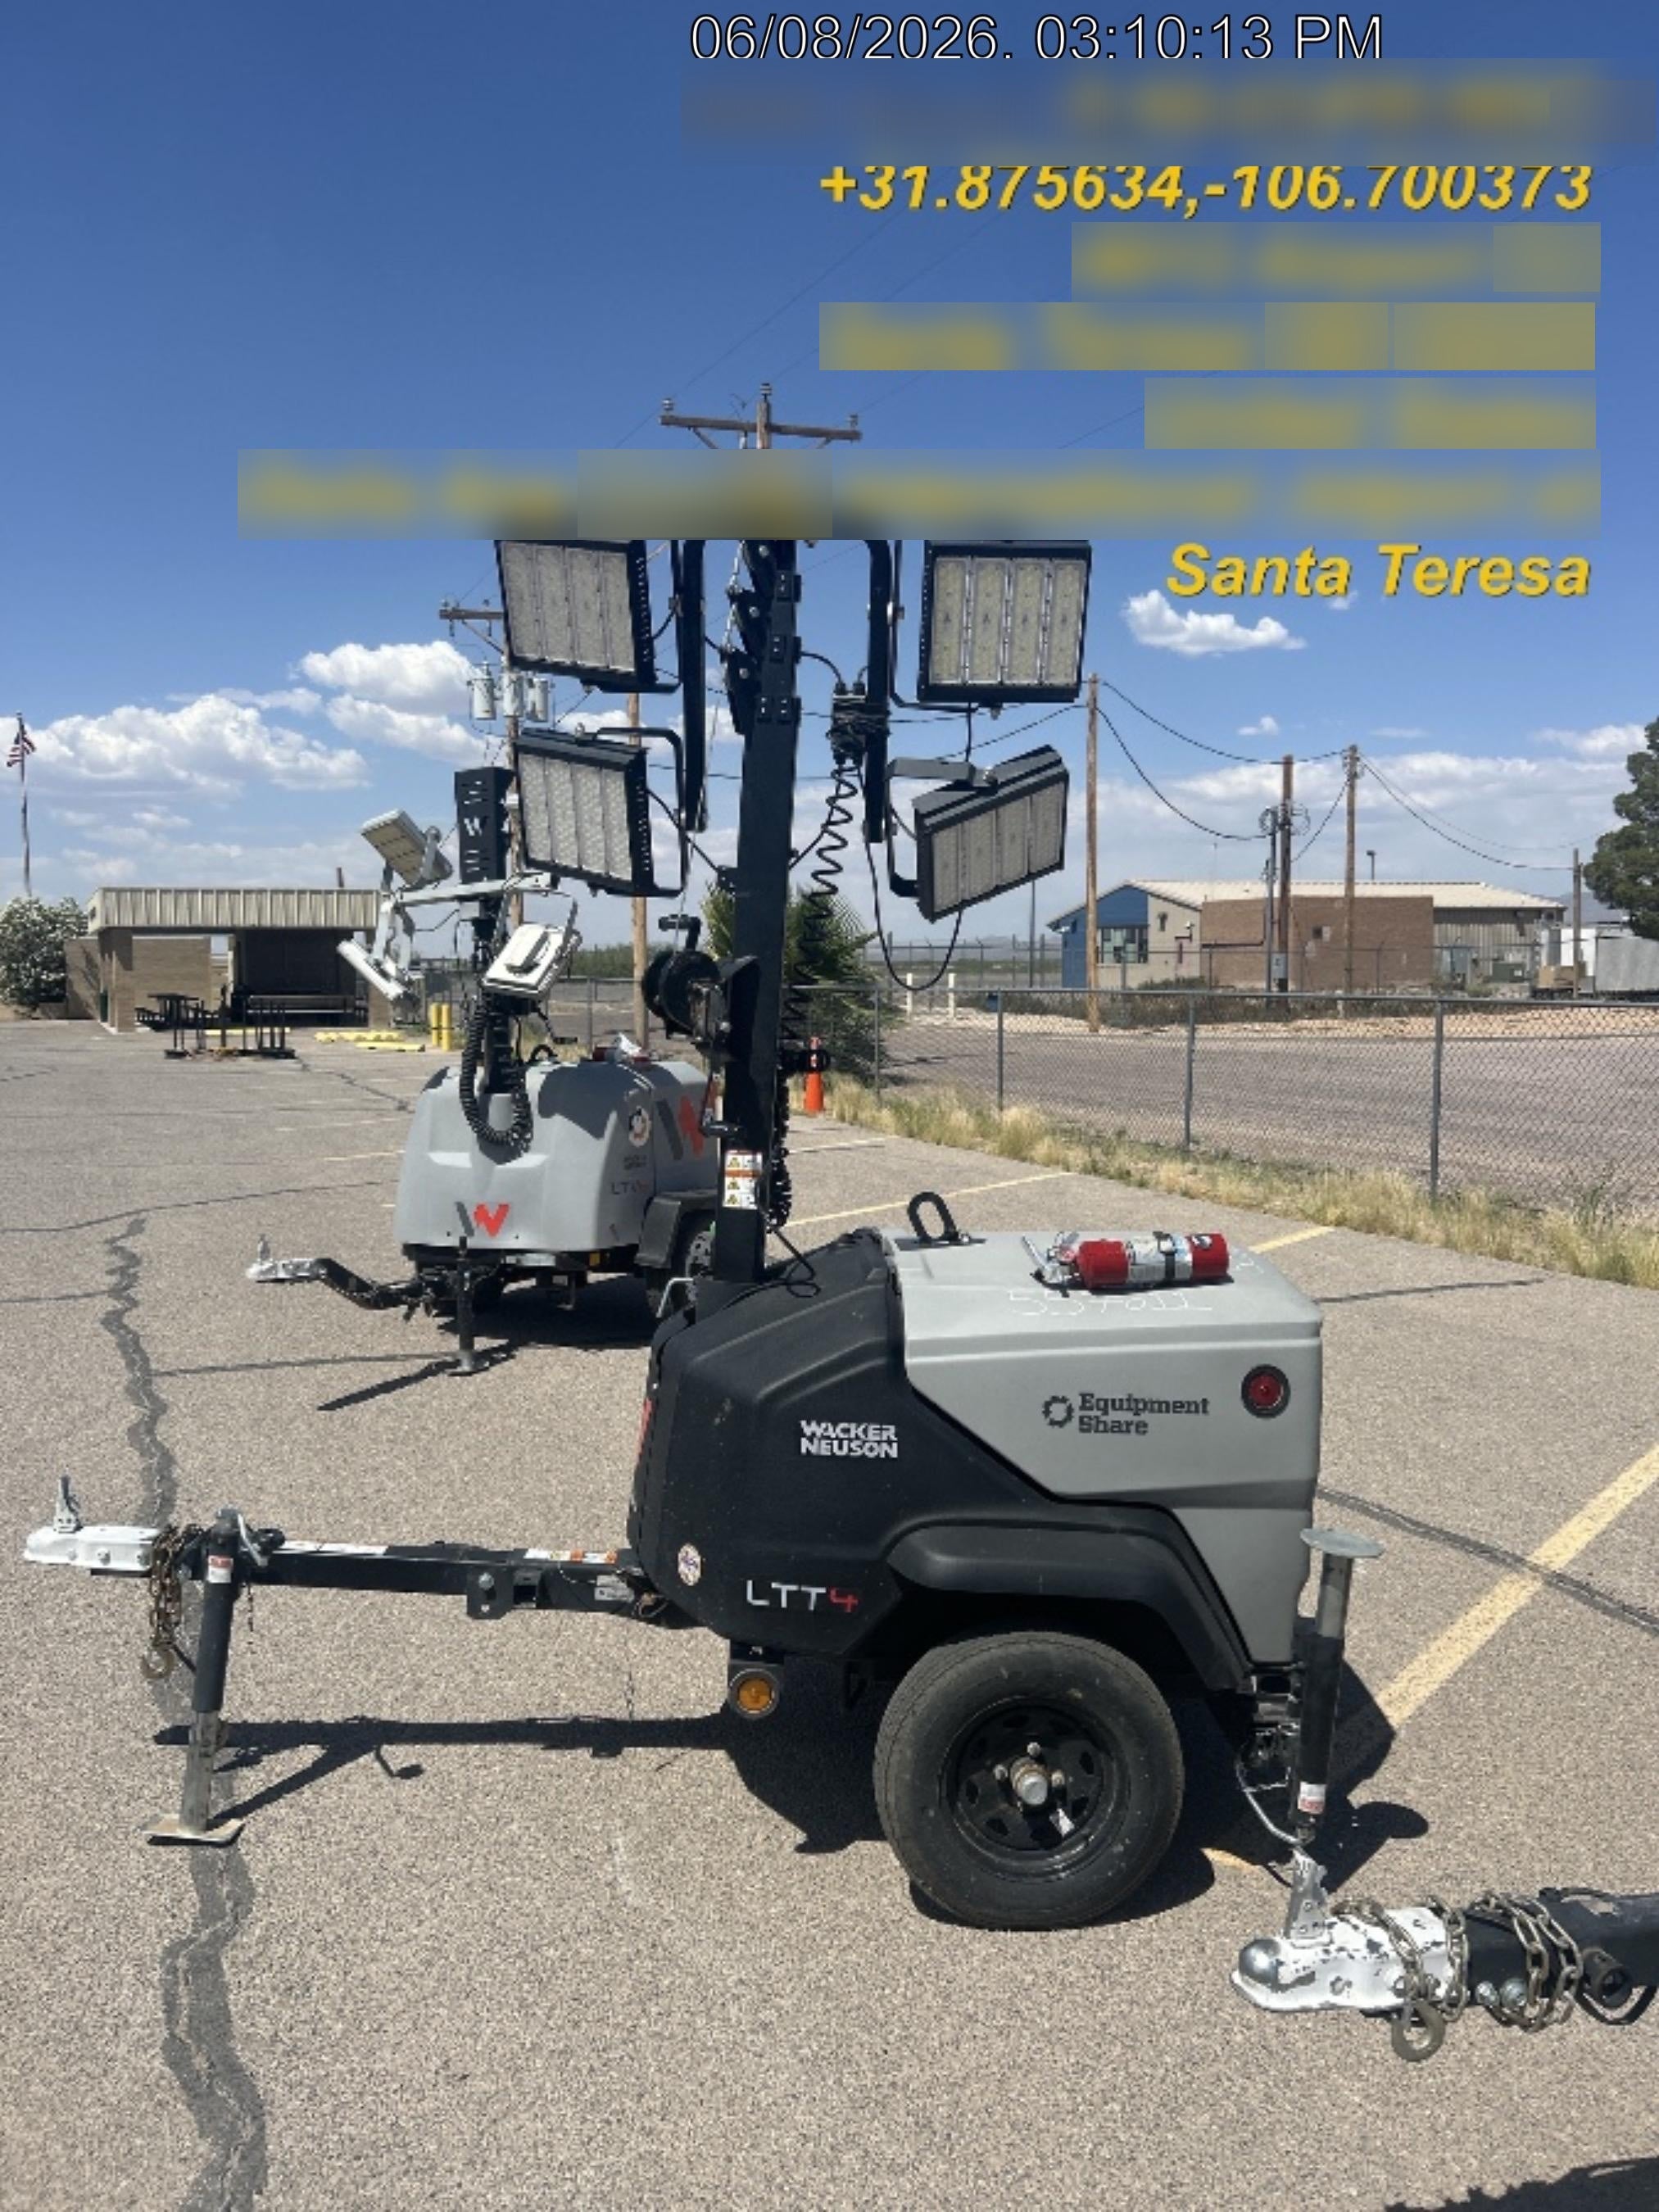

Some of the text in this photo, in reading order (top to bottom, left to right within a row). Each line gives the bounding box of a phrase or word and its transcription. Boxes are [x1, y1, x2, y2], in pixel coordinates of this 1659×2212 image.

[1078, 1392, 1210, 1416] Equipment
[800, 1419, 899, 1442] WACKER
[1078, 1415, 1149, 1436] Share
[800, 1437, 899, 1459] NEUSON
[746, 1579, 859, 1614] LTT4
